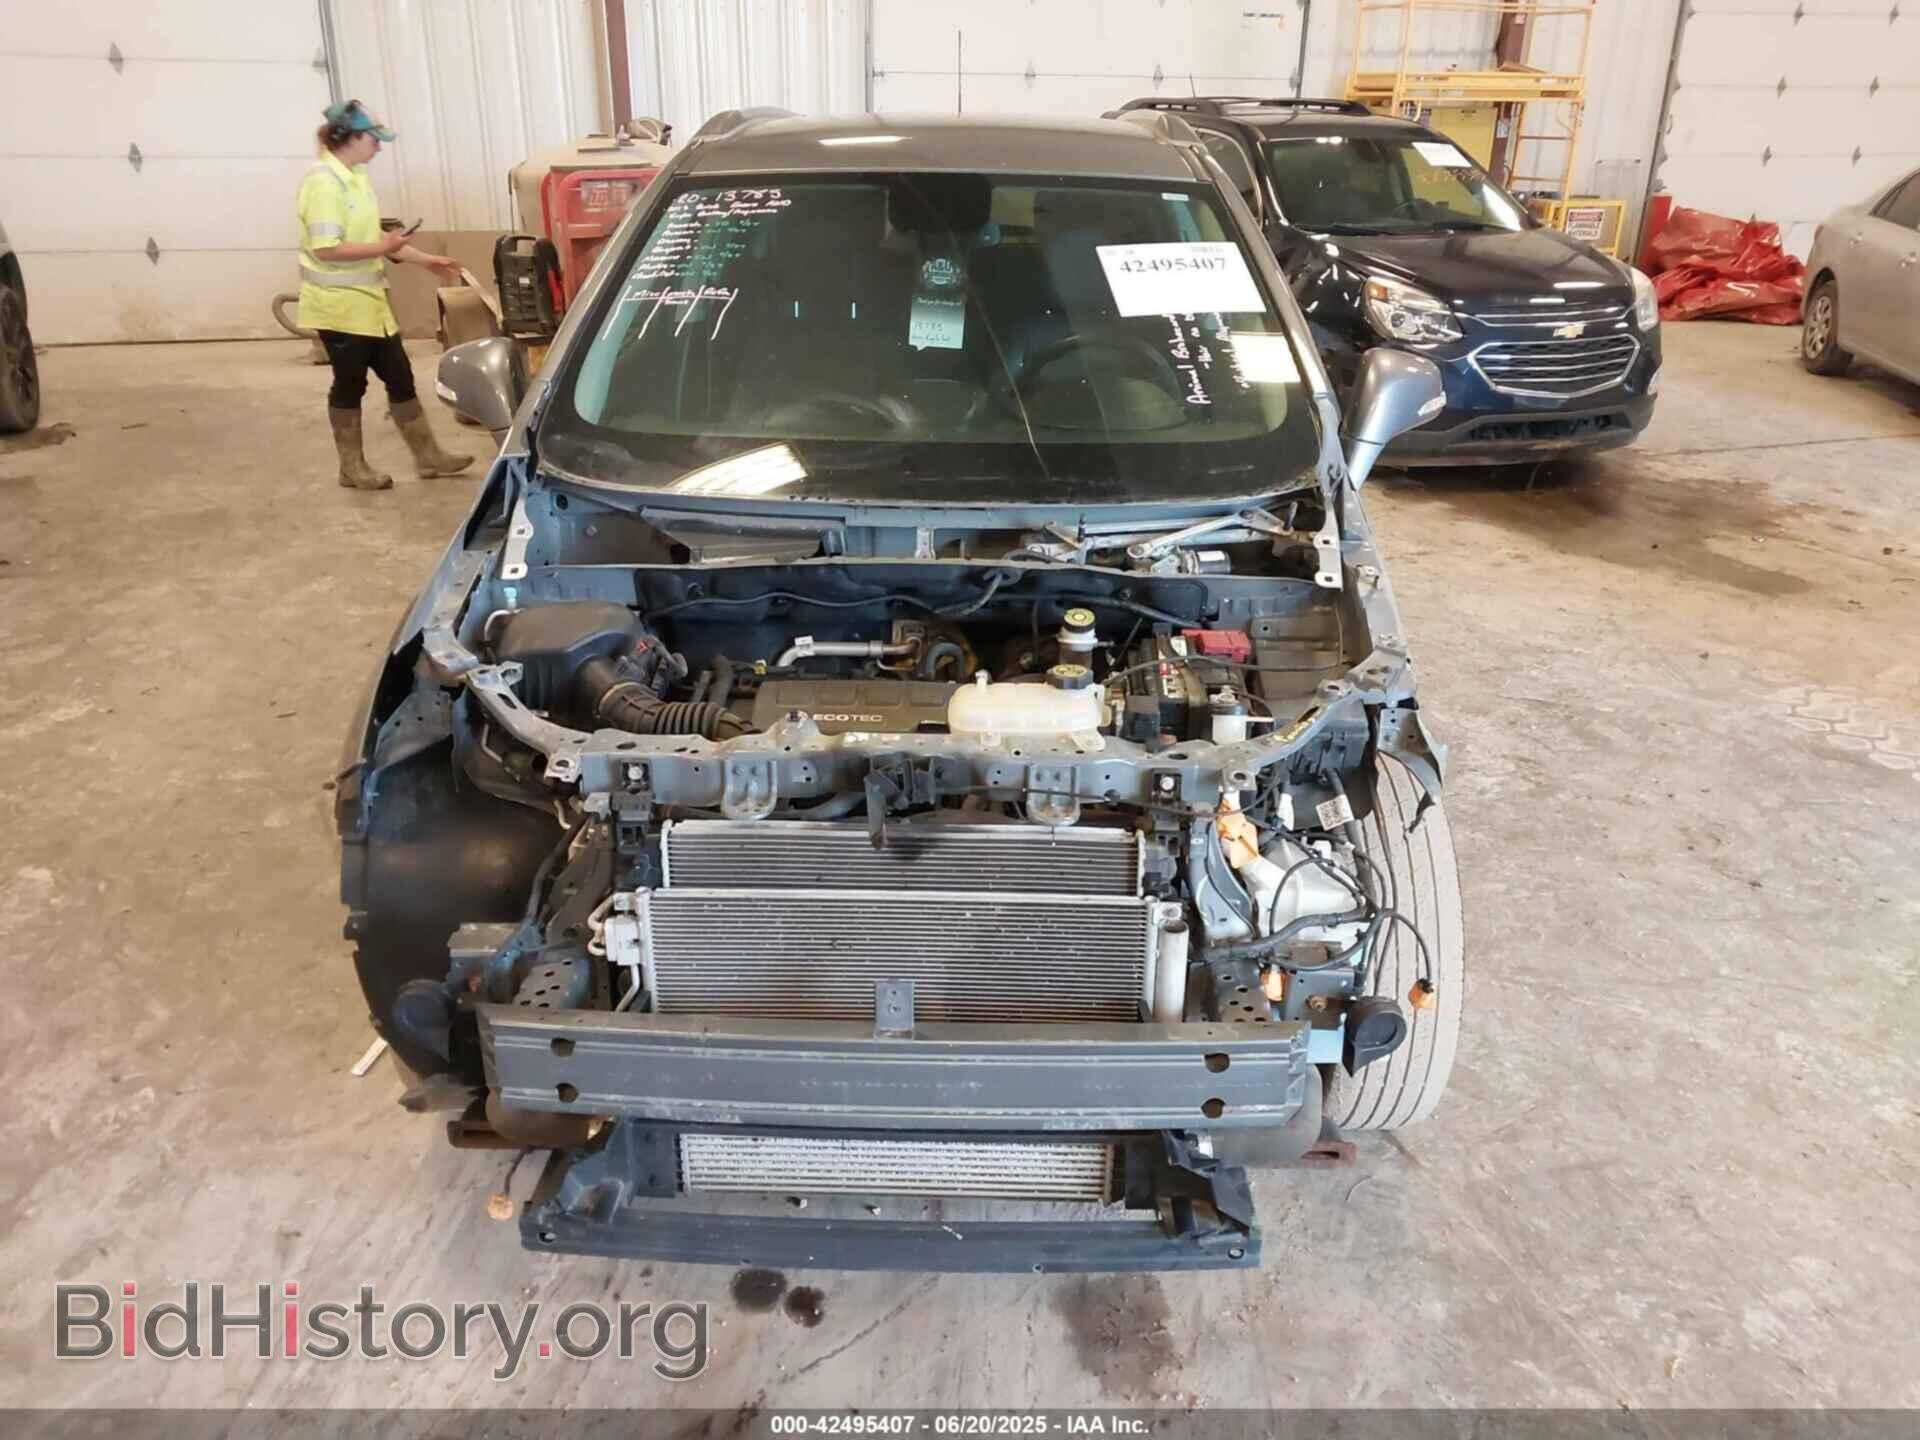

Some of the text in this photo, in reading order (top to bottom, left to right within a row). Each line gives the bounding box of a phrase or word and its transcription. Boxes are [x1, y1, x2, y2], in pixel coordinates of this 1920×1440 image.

[1120, 257, 1226, 273] 42495407
[1176, 365, 1213, 405] Animal
[812, 713, 884, 723] ECOTEC
